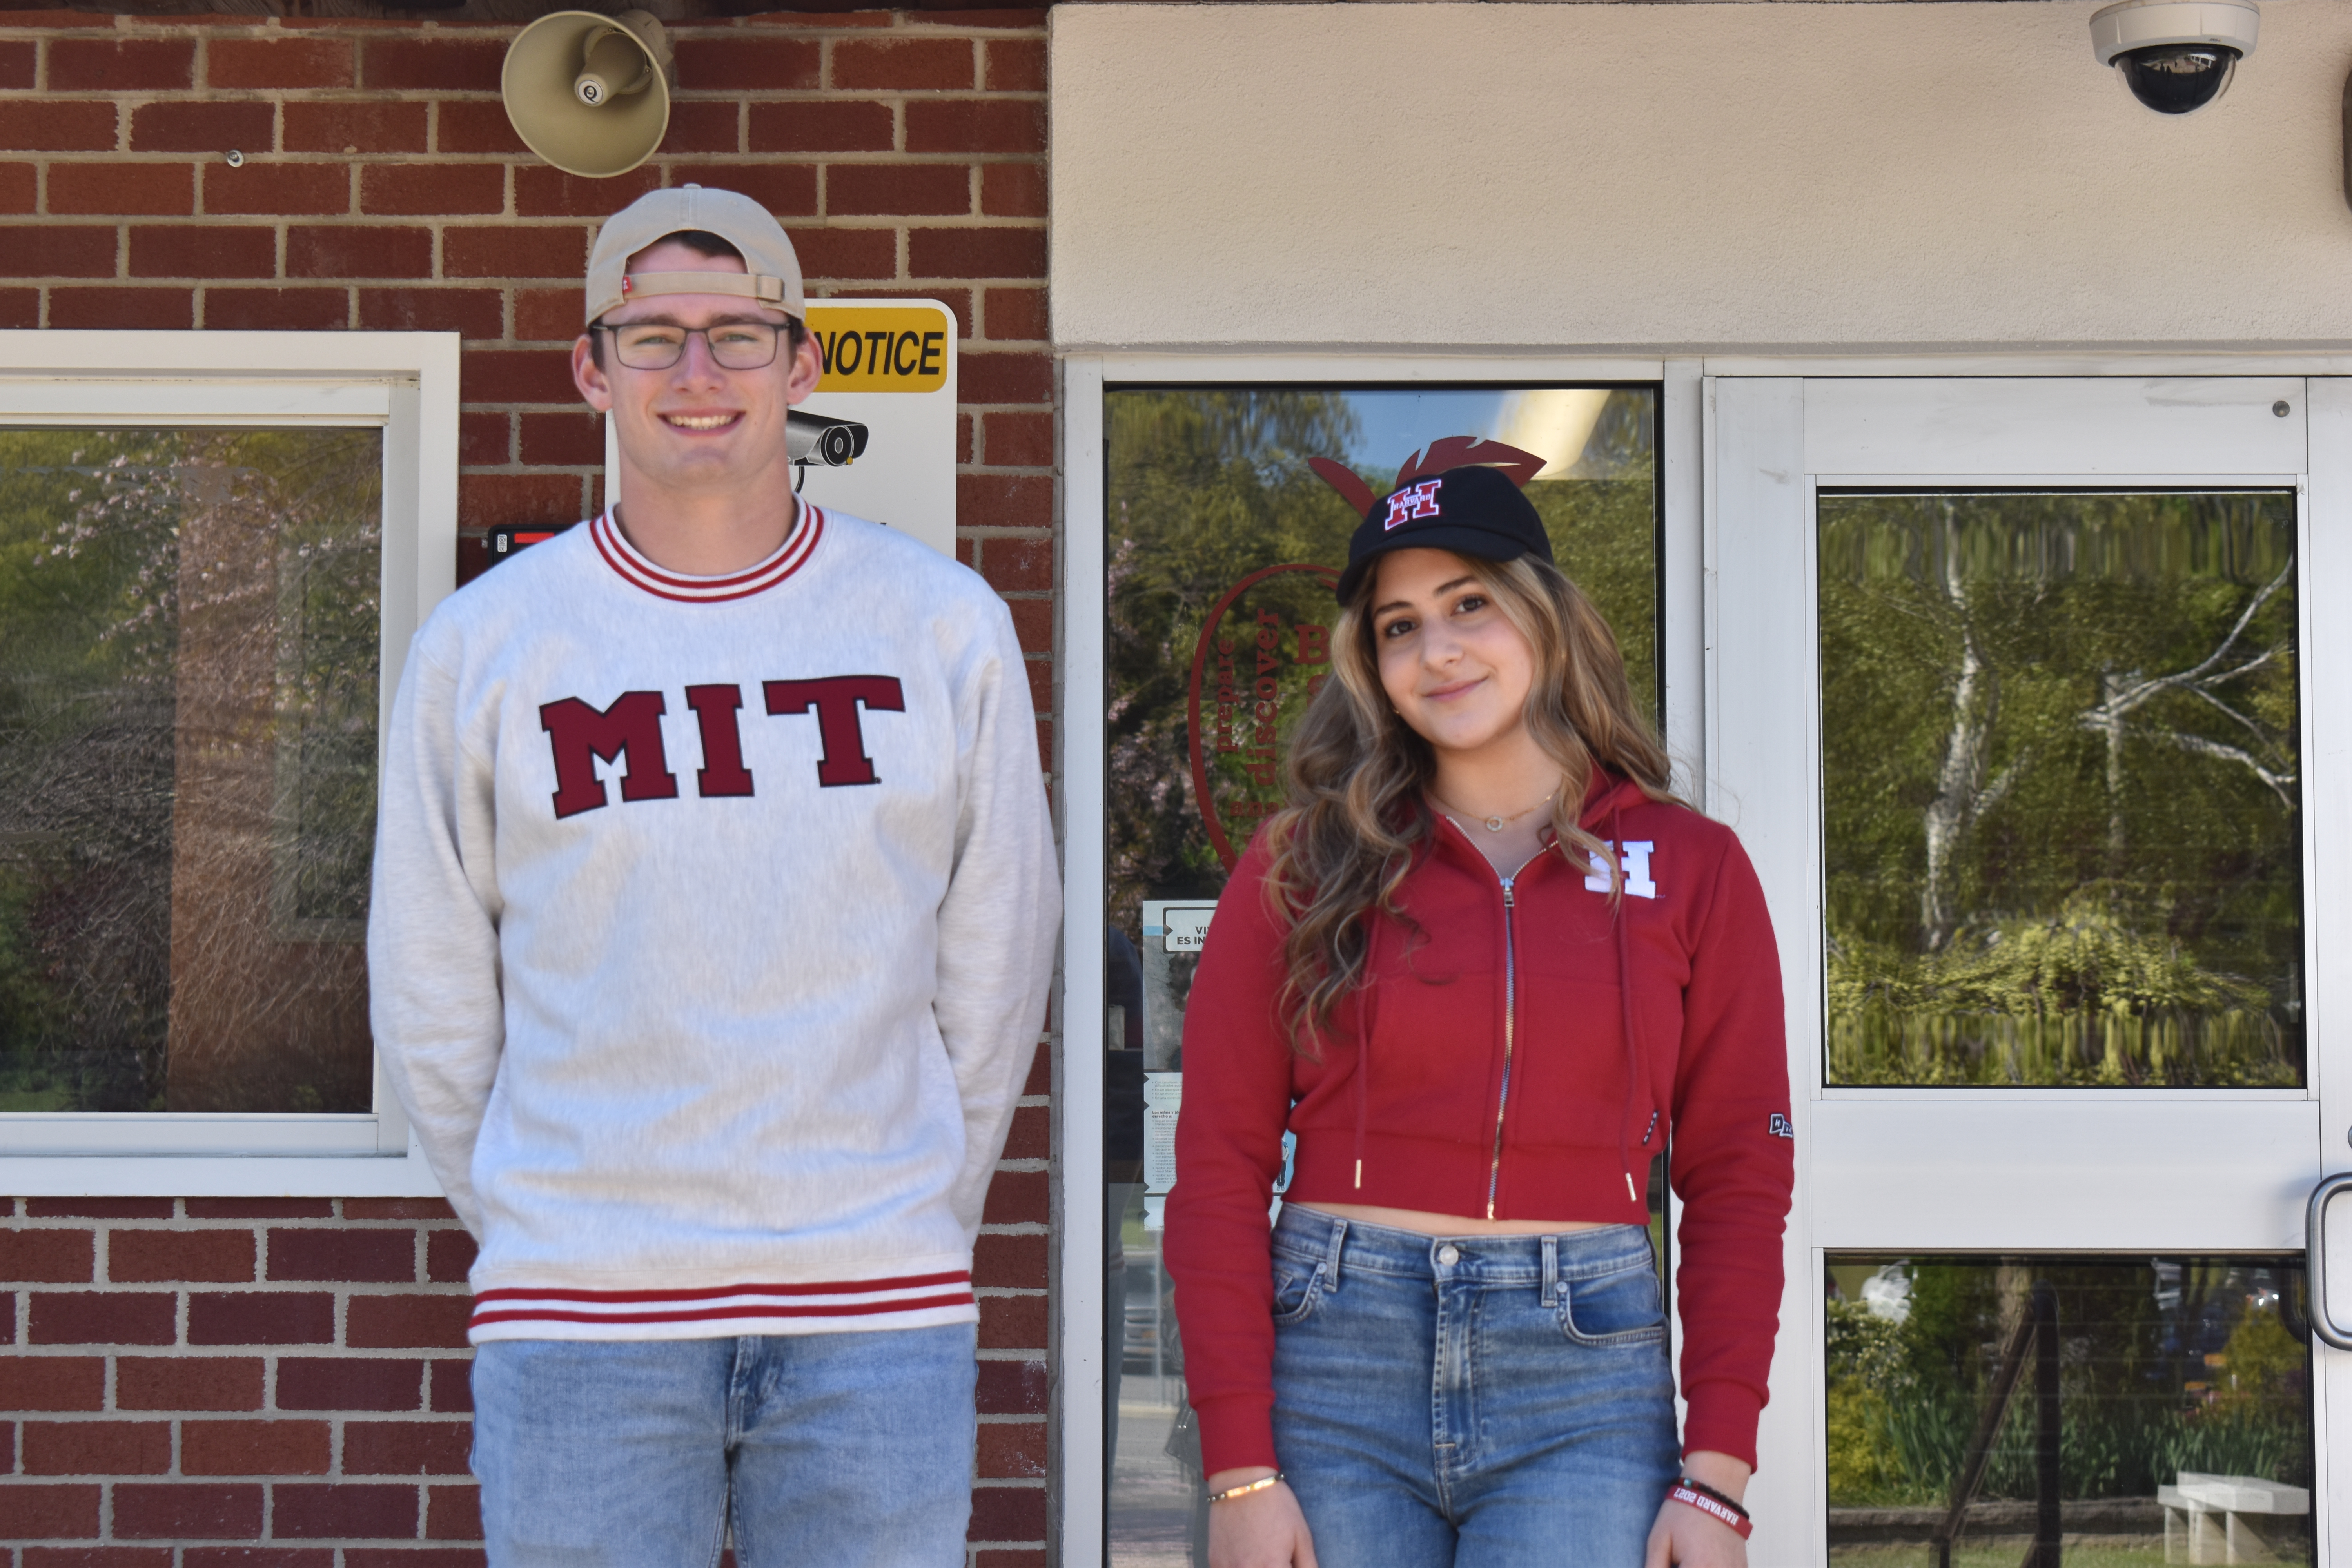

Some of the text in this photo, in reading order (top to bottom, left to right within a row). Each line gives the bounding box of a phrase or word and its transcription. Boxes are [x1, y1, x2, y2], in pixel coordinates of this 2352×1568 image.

[1394, 494, 1431, 510] HARVARD
[1217, 639, 1239, 753] prepare
[1246, 607, 1279, 785] discover
[539, 675, 906, 820] MIT
[1177, 936, 1191, 945] ES
[1195, 926, 1209, 935] VI
[1673, 1488, 1739, 1526] HARVARD 2027
